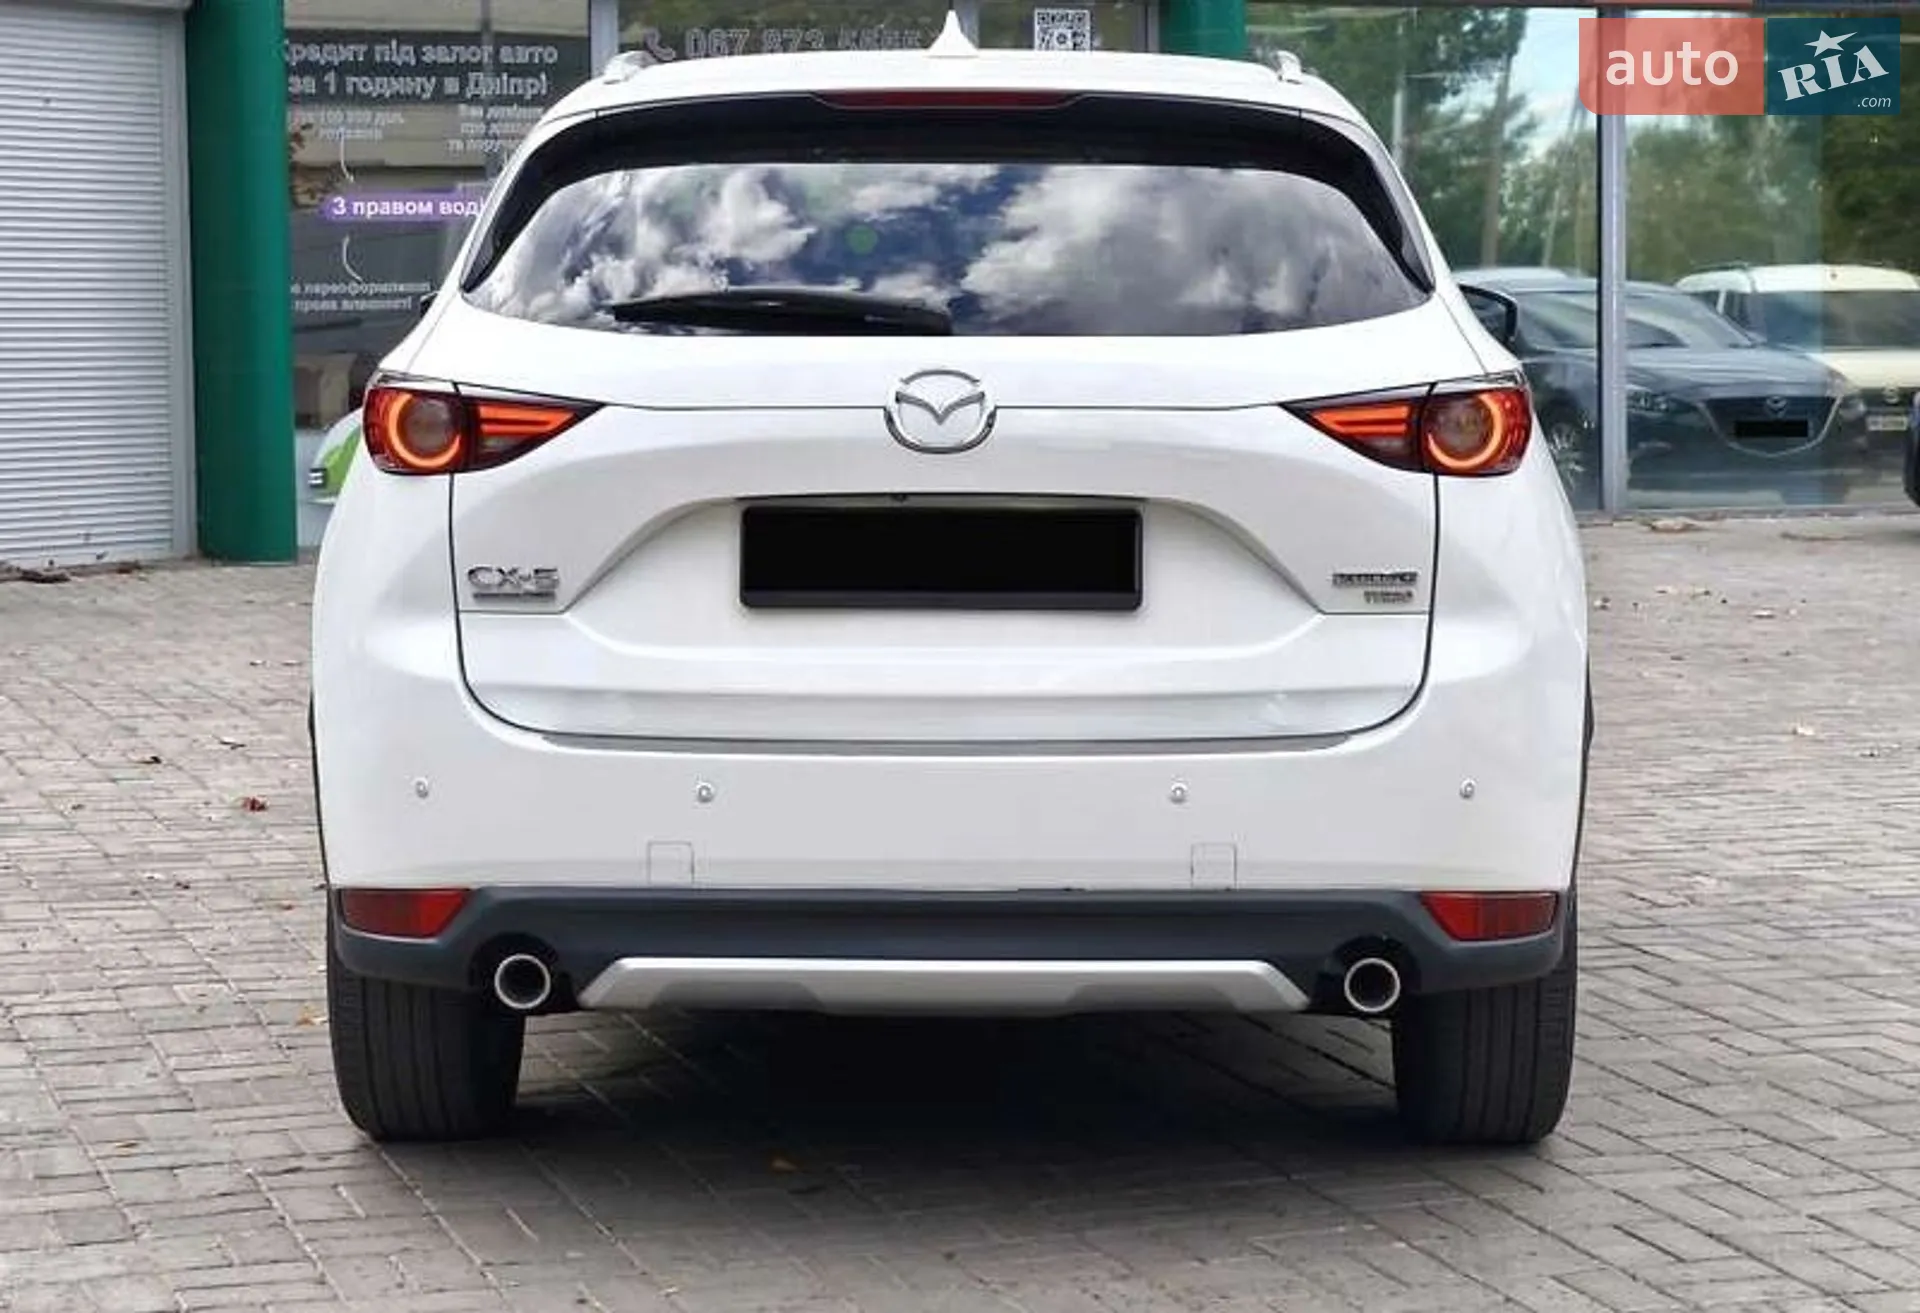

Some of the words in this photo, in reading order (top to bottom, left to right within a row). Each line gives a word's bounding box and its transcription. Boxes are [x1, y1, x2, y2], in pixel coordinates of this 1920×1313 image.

[374, 38, 416, 66] під
[422, 45, 493, 64] залог
[500, 45, 558, 64] авто
[288, 75, 316, 95] за
[323, 69, 337, 95] 1
[345, 75, 437, 99] годину
[332, 197, 346, 215] З
[353, 201, 433, 219] правом
[467, 565, 560, 590] CX-5
